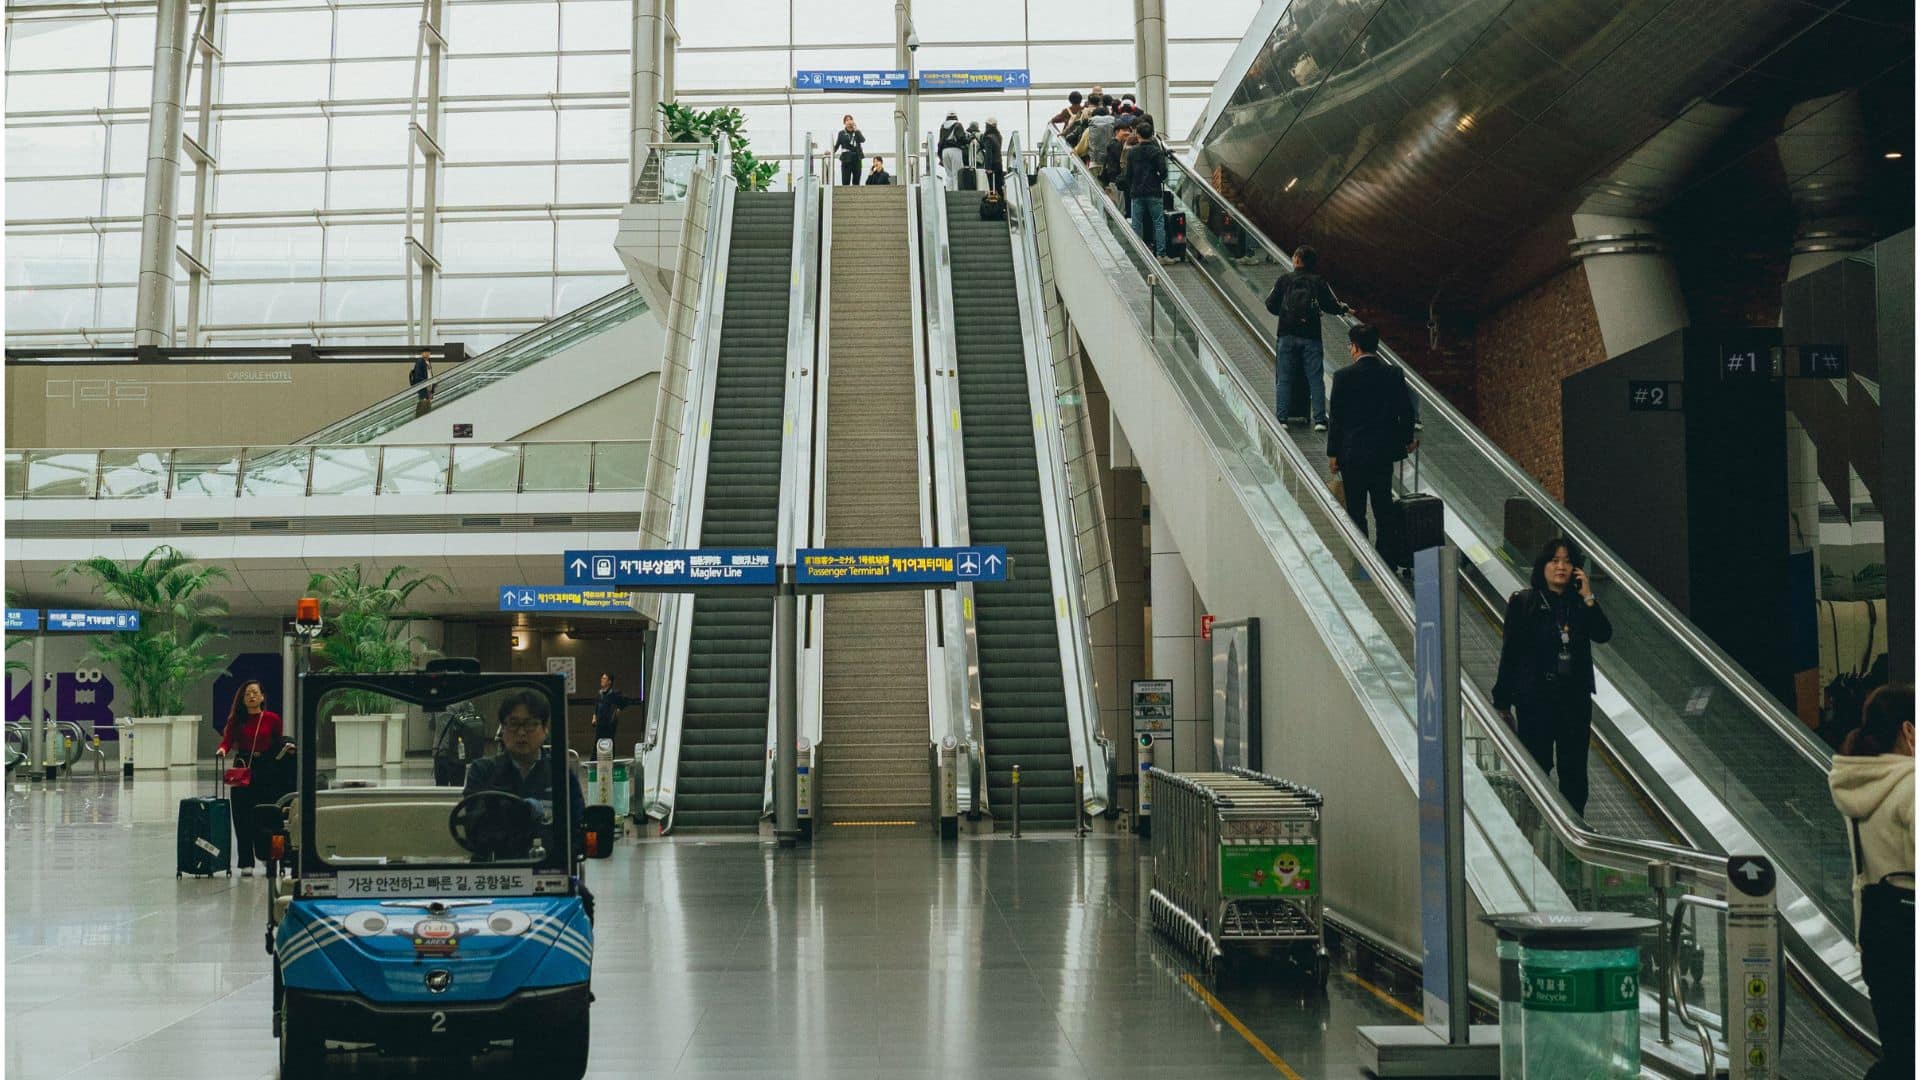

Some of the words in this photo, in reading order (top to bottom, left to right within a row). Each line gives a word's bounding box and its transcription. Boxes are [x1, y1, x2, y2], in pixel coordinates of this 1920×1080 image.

[1728, 352, 1757, 372] #1
[1633, 387, 1665, 406] #2
[620, 560, 685, 575] 자기부상열차
[690, 567, 722, 579] Maglev
[724, 566, 742, 577] Line
[808, 566, 847, 577] Passenger
[849, 565, 883, 576] Terminal
[885, 566, 889, 576] 1
[892, 558, 953, 573] 제1여객터미널
[348, 877, 372, 892] 가장
[376, 877, 425, 892] 안전하고
[428, 876, 452, 891] 빠른
[456, 877, 472, 892] 길,
[474, 875, 523, 890] 공항철도
[1536, 992, 1567, 1001] Recycle
[431, 1011, 447, 1032] 2
